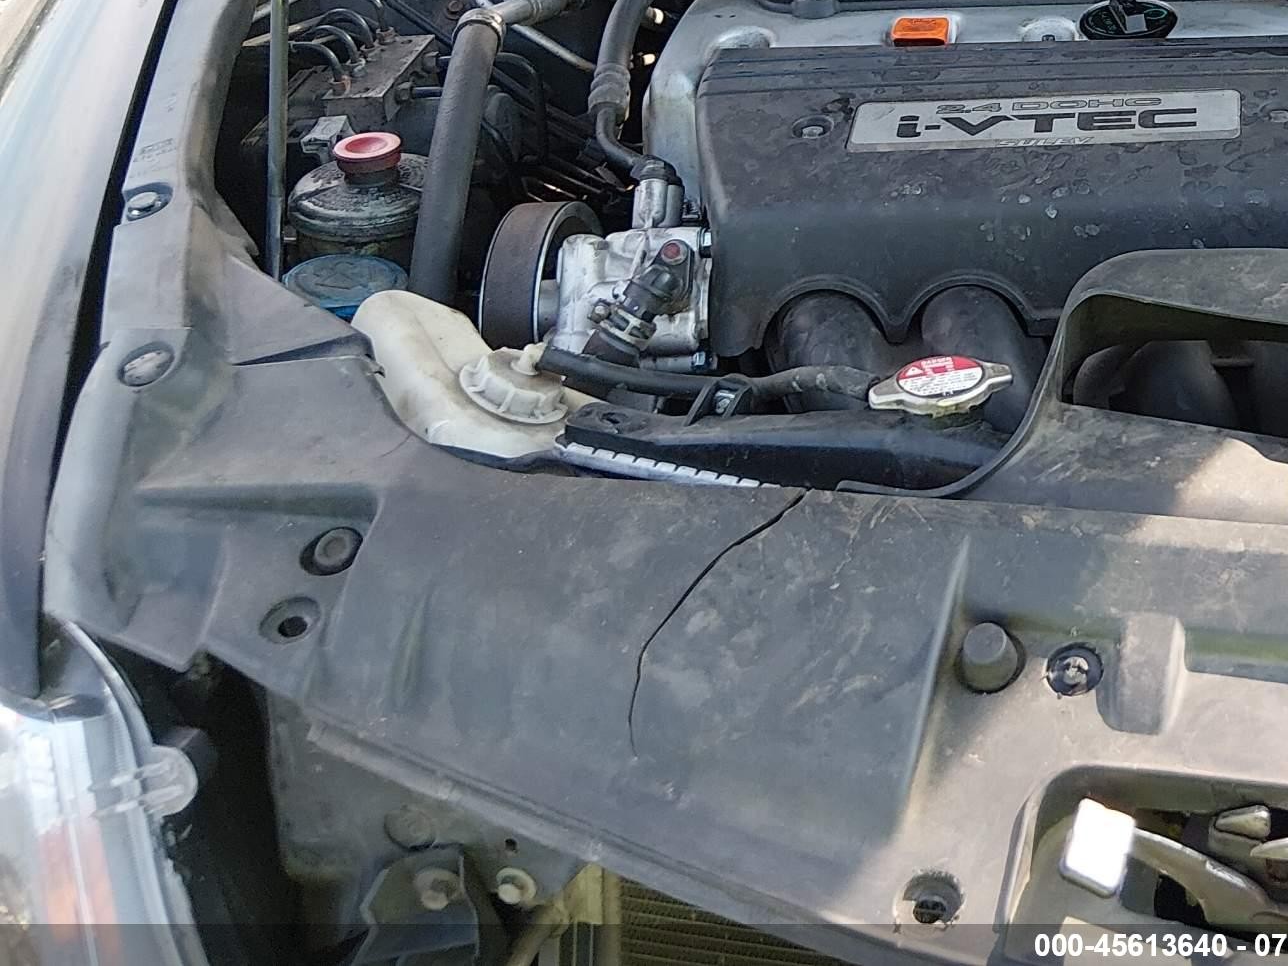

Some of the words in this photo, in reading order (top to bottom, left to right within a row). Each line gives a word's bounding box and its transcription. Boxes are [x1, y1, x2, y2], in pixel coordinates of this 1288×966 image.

[936, 101, 1002, 114] 2.4
[1011, 97, 1163, 112] DOHC
[896, 108, 1198, 139] i-VTEC
